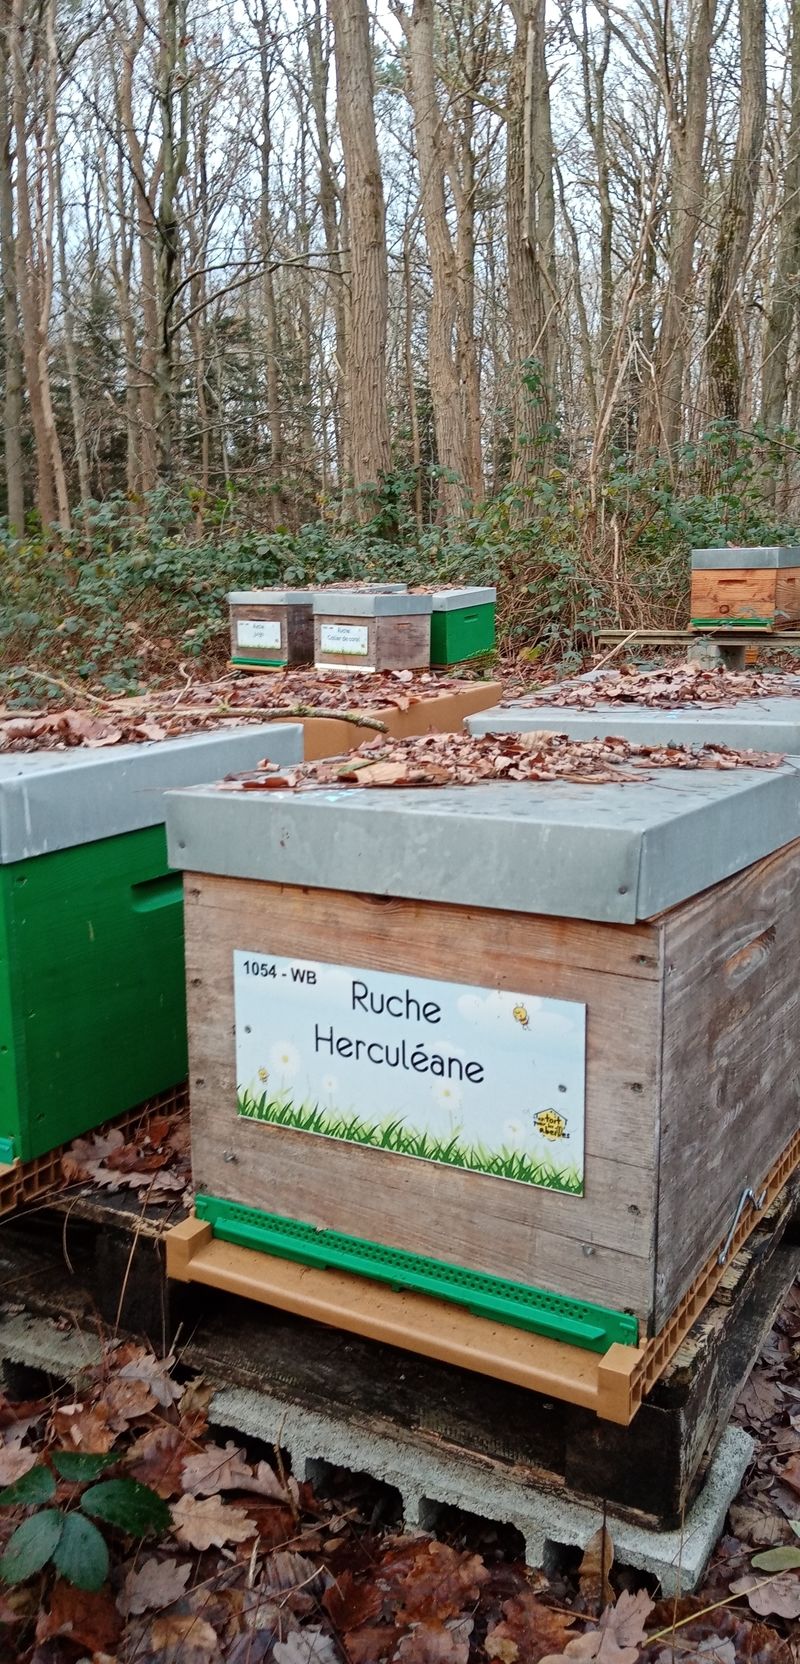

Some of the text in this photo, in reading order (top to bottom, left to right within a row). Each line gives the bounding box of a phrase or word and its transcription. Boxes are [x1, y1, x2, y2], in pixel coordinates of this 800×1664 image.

[243, 960, 277, 979] 1054
[290, 967, 317, 985] WB
[351, 980, 441, 1024] Ruche
[314, 1023, 485, 1084] Herculéane
